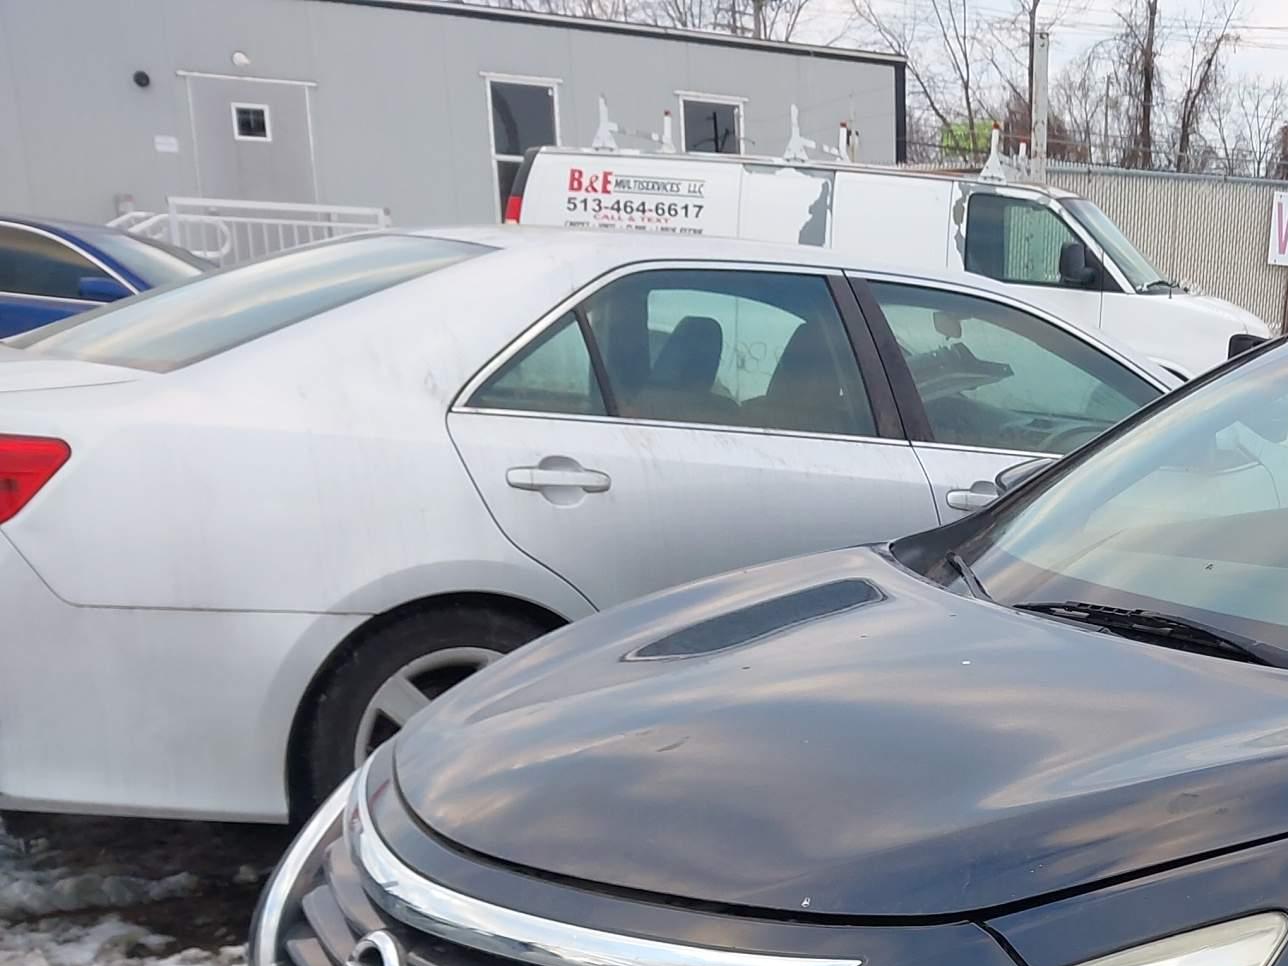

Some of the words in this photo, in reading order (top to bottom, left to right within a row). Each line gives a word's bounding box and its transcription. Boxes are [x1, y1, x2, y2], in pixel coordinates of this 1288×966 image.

[614, 178, 681, 193] MULTISERVICES
[688, 183, 704, 194] LLC
[566, 197, 704, 218] 513-464-6617
